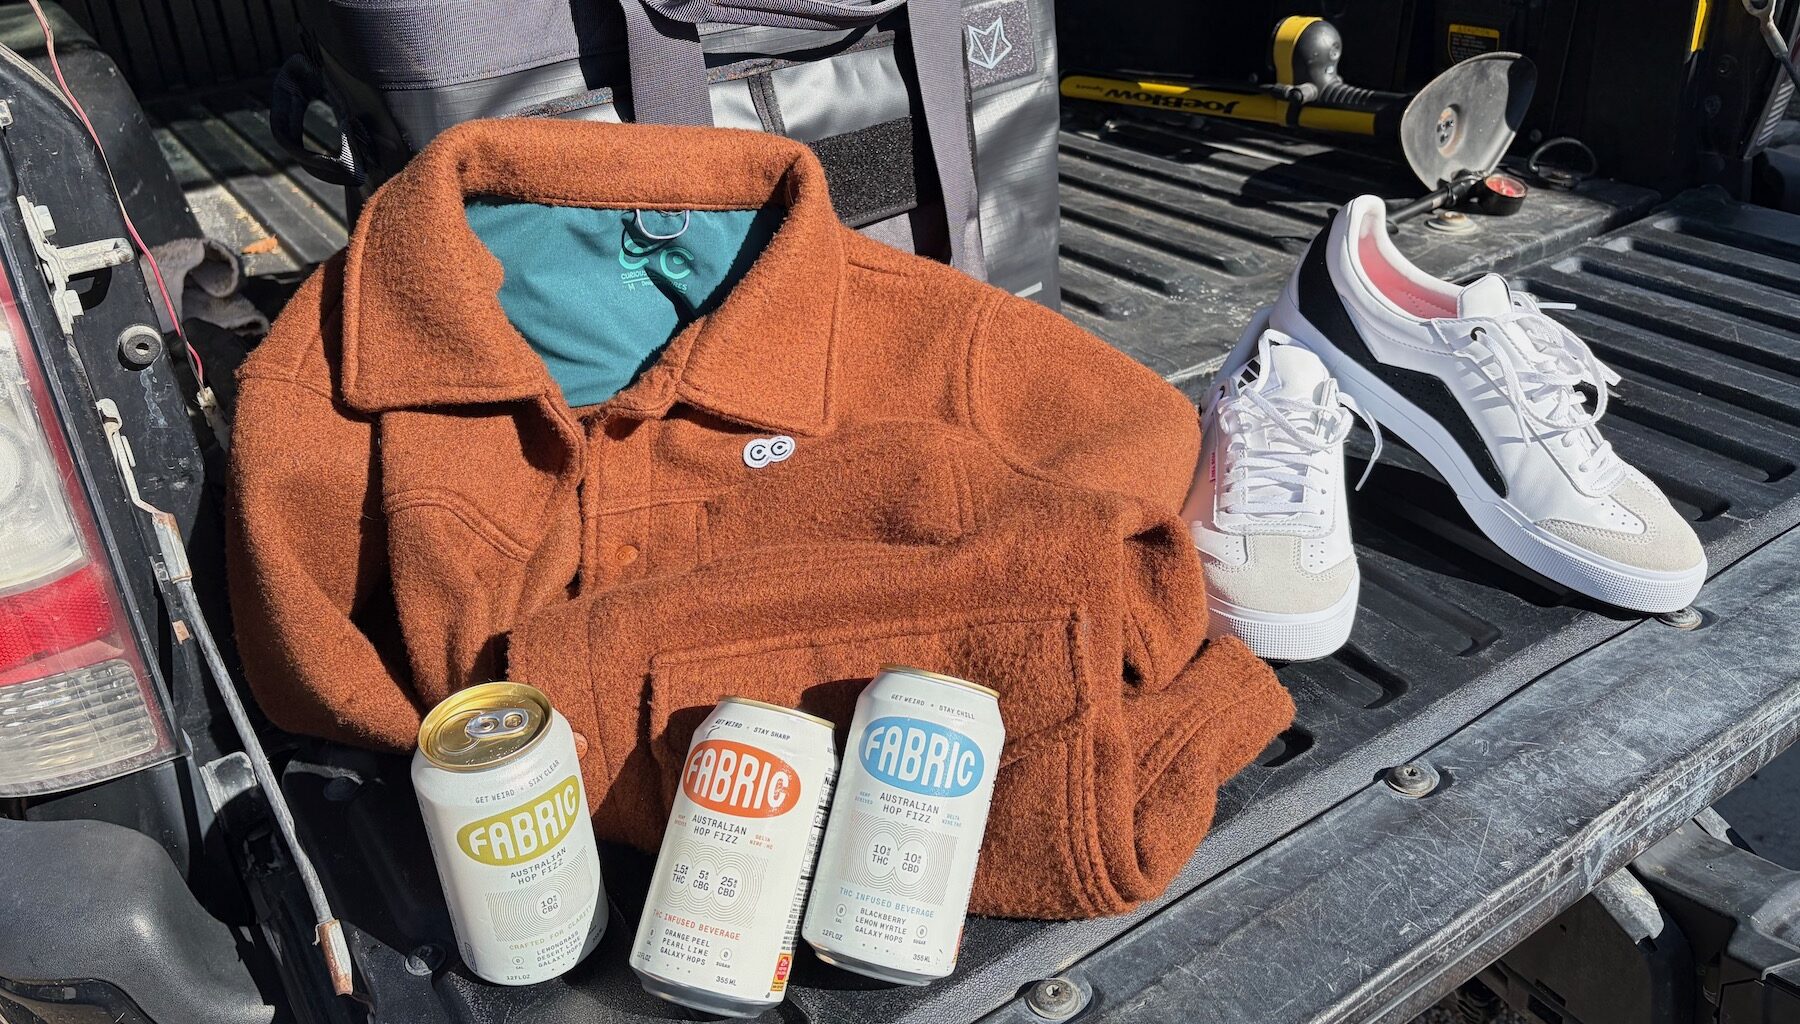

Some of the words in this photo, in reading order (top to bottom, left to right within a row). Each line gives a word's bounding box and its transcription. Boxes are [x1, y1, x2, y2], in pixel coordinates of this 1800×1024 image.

[1104, 89, 1240, 115] JoeBlow
[905, 697, 925, 706] WEIRD
[939, 705, 955, 715] STAY
[956, 710, 976, 720] CHILL
[725, 720, 743, 729] WEIRD
[754, 727, 770, 736] STAY
[771, 731, 791, 741] SHARP
[865, 726, 976, 789] FABRIC
[475, 796, 489, 804] GET
[492, 789, 515, 801] WEIRD
[528, 774, 544, 788] STAY
[544, 760, 560, 777] CLEAR
[687, 748, 789, 810] FABRIC
[880, 792, 940, 814] AUSTRALIAN
[469, 785, 576, 860] FABRIC
[883, 804, 902, 816] HOP
[906, 811, 932, 824] FIZZ
[692, 814, 748, 836] AUSTRALIAN
[694, 826, 711, 837] HOP
[714, 831, 739, 845] FIZZ
[510, 847, 567, 879] AUSTRALIAN
[872, 854, 889, 866] THC
[902, 862, 920, 874] CBD
[518, 874, 537, 885] HOP
[542, 859, 564, 876] FIZZ
[672, 873, 686, 884] THC
[693, 880, 710, 891] CBG
[718, 887, 735, 898] CBD
[542, 903, 558, 915] CBG
[840, 887, 853, 897] THC
[855, 890, 892, 909] INFUSED
[895, 903, 934, 918] BEVERAGE
[664, 913, 696, 929] INFUSED
[698, 923, 741, 940] BEVERAGE
[856, 916, 878, 928] LEMON
[880, 923, 907, 935] MYRTLE
[860, 908, 907, 925] BLACKBERRY
[509, 938, 545, 951] CRAFTED
[537, 930, 579, 955] LEMONGRASS
[665, 929, 690, 942] ORANGE
[691, 936, 710, 948] PEEL
[855, 926, 882, 939] GALAXY
[885, 934, 903, 944] HOPS
[537, 947, 563, 962] DESERT
[566, 937, 581, 949] LIME
[538, 953, 565, 968] GALAXY
[567, 942, 583, 956] HOPS
[660, 947, 685, 960] GALAXY
[686, 956, 706, 966] HOPS
[662, 937, 685, 950] PEARL
[688, 946, 709, 957] LIME
